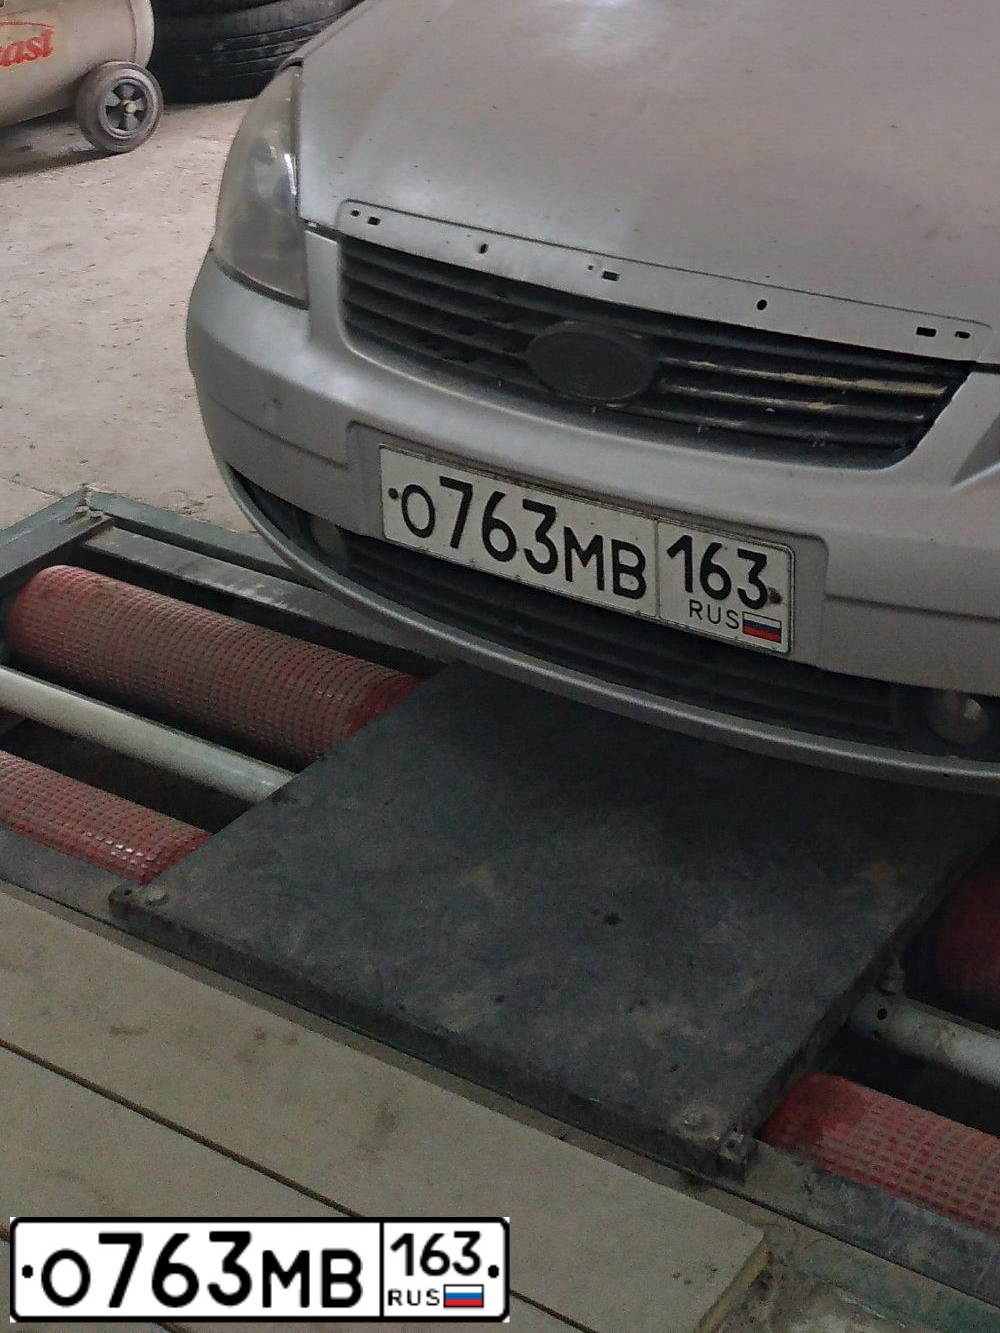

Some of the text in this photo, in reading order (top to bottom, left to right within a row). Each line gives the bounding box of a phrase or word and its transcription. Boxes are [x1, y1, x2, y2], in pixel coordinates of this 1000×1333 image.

[401, 475, 769, 610] O763MB 163
[689, 599, 740, 630] RUS
